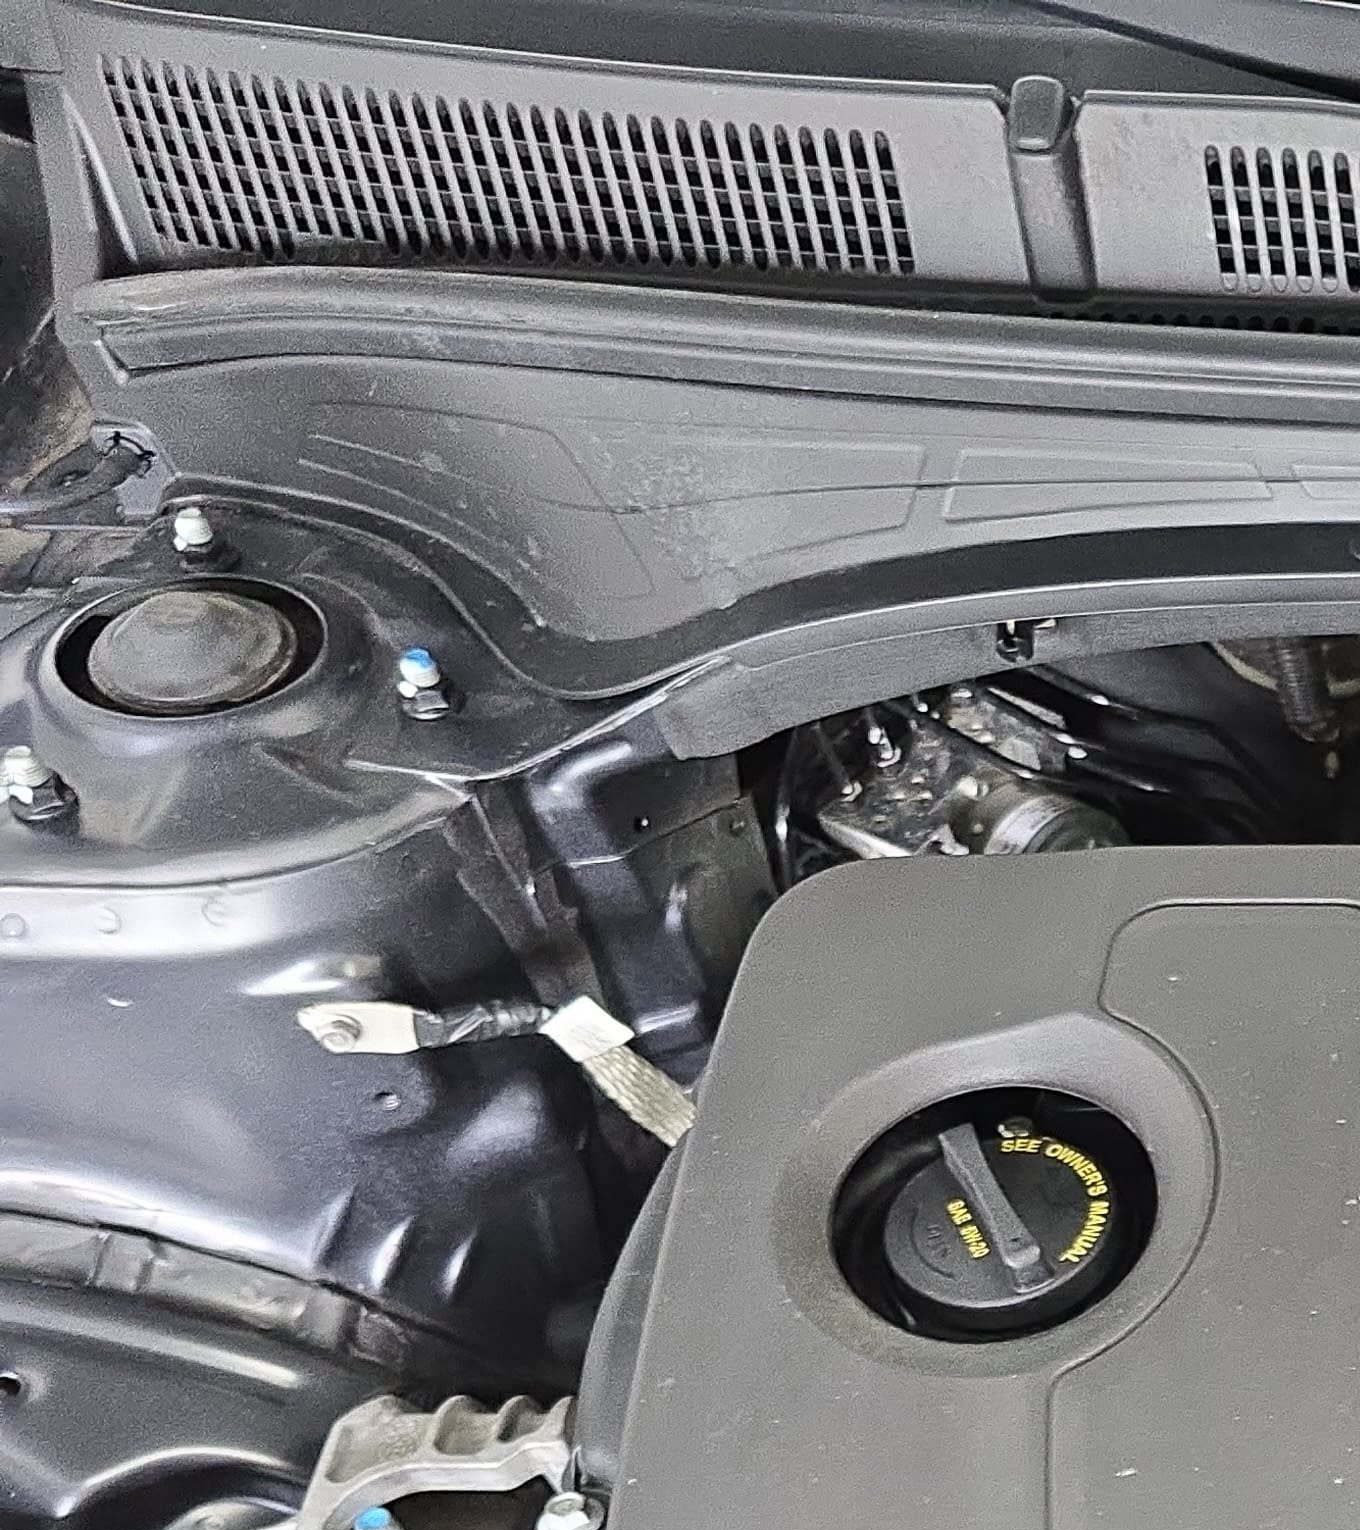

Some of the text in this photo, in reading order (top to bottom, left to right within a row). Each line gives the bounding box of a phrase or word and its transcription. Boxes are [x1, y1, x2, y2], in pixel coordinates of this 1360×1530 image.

[1001, 1138, 1110, 1264] SEE OWNER'S MANUAL
